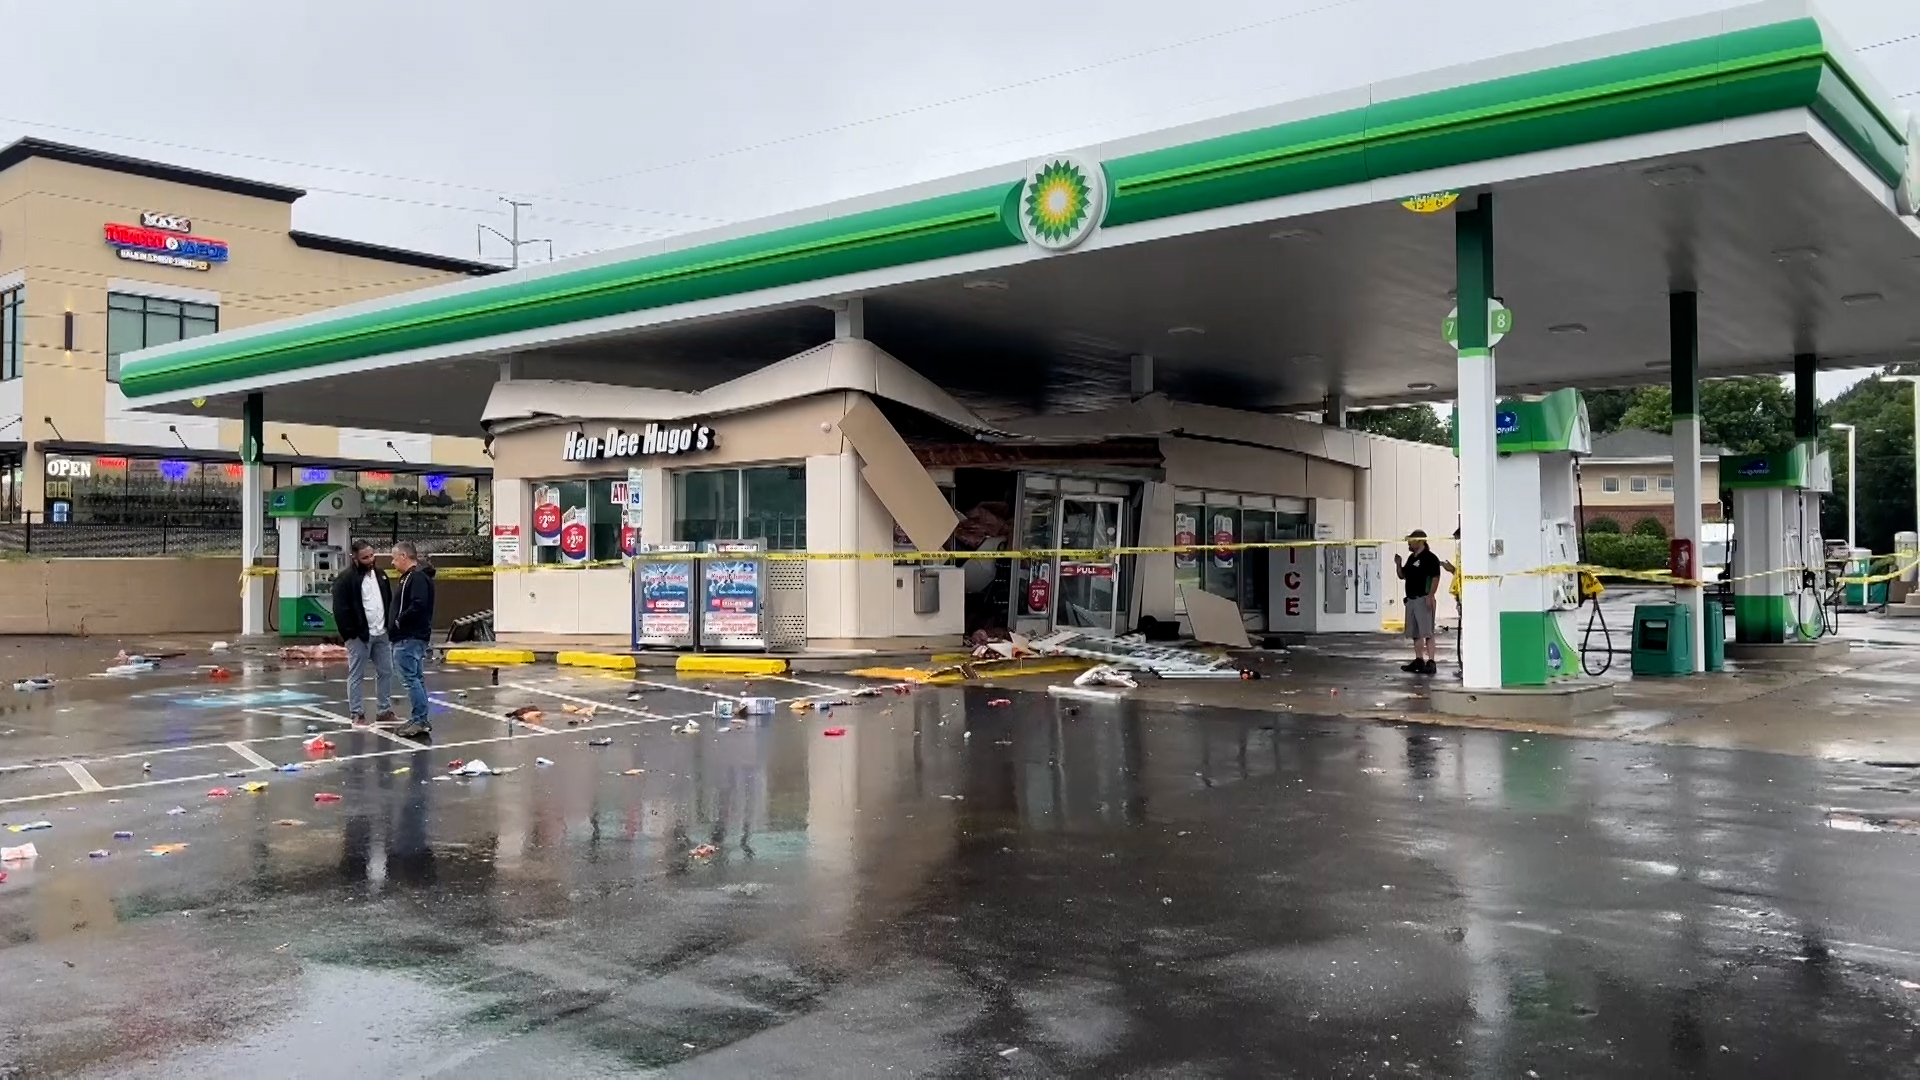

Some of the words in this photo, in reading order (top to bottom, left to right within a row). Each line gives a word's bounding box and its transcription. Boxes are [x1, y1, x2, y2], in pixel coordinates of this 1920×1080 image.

[1446, 321, 1455, 336] 7
[1497, 313, 1506, 329] 8
[562, 427, 640, 461] Han-Dee
[643, 422, 710, 455] Hugo's
[47, 459, 92, 477] OPEN
[1076, 566, 1097, 575] PULL
[1284, 546, 1301, 616] ICE
